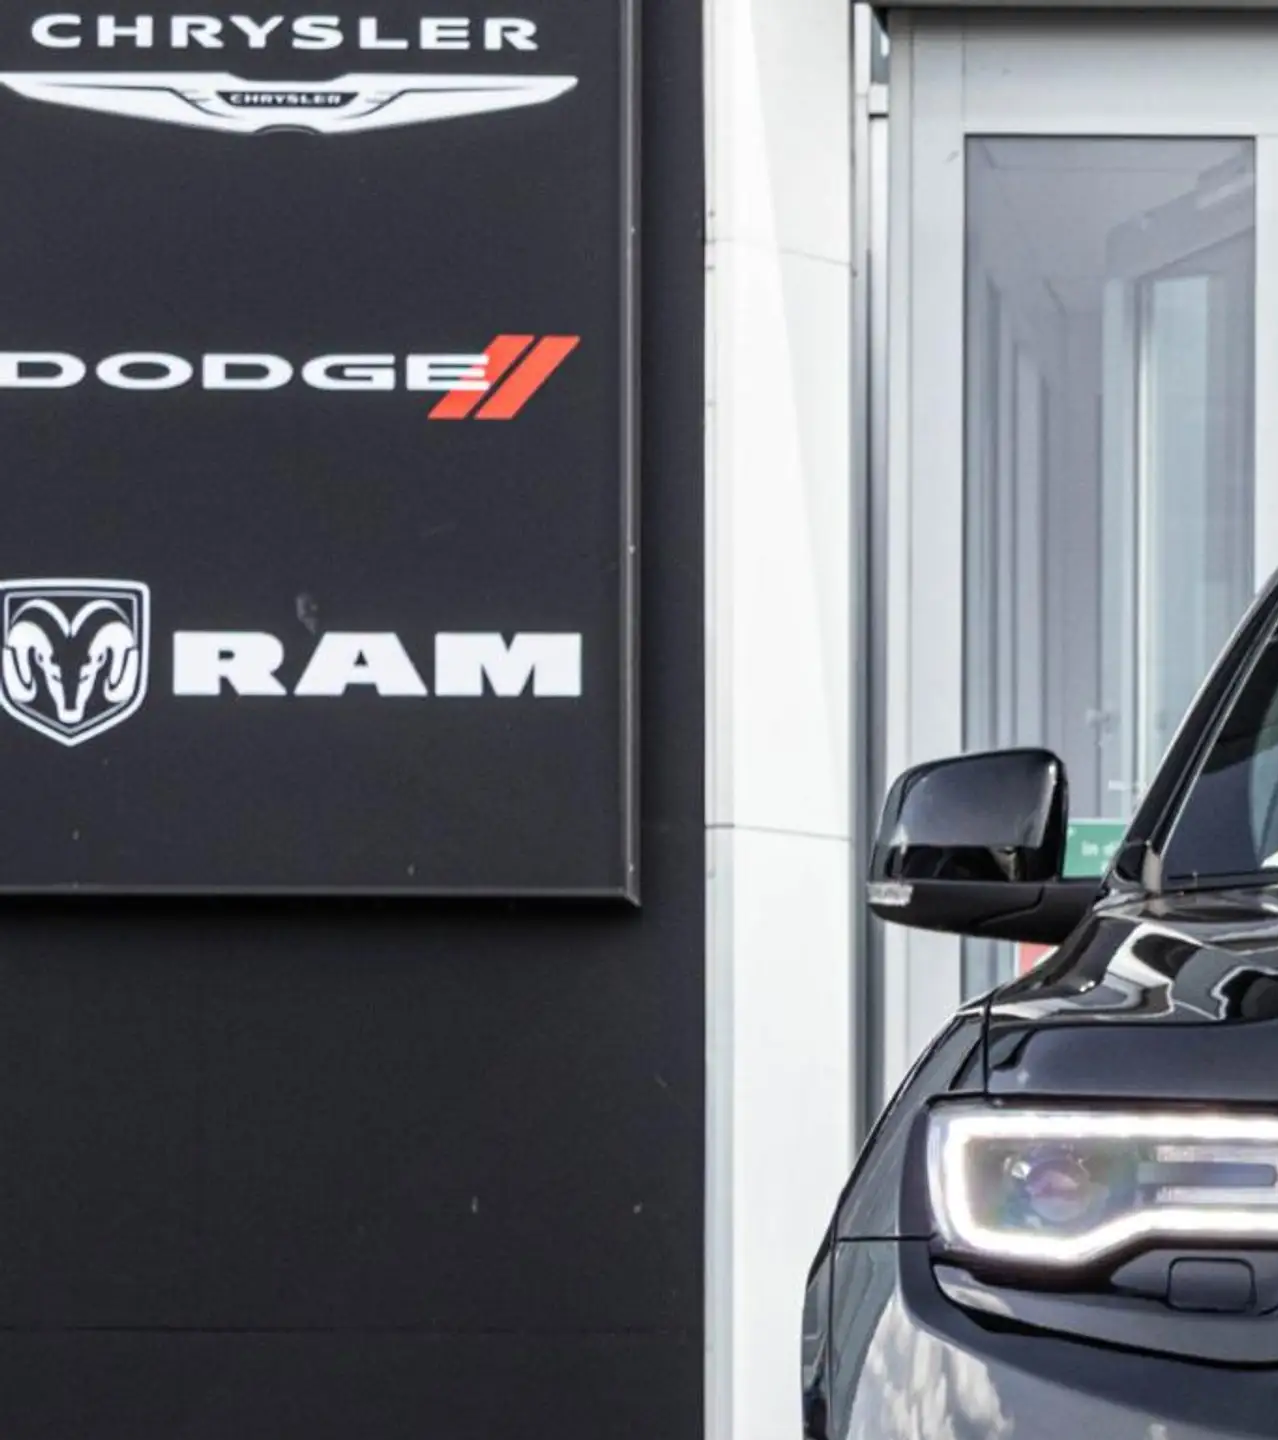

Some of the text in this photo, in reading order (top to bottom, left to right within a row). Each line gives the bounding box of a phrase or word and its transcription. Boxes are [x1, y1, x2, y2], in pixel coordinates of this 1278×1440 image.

[32, 14, 538, 50] CHRYSLER
[229, 93, 342, 105] CHRYSLER
[0, 352, 490, 391] DODGE
[173, 631, 582, 697] RAM
